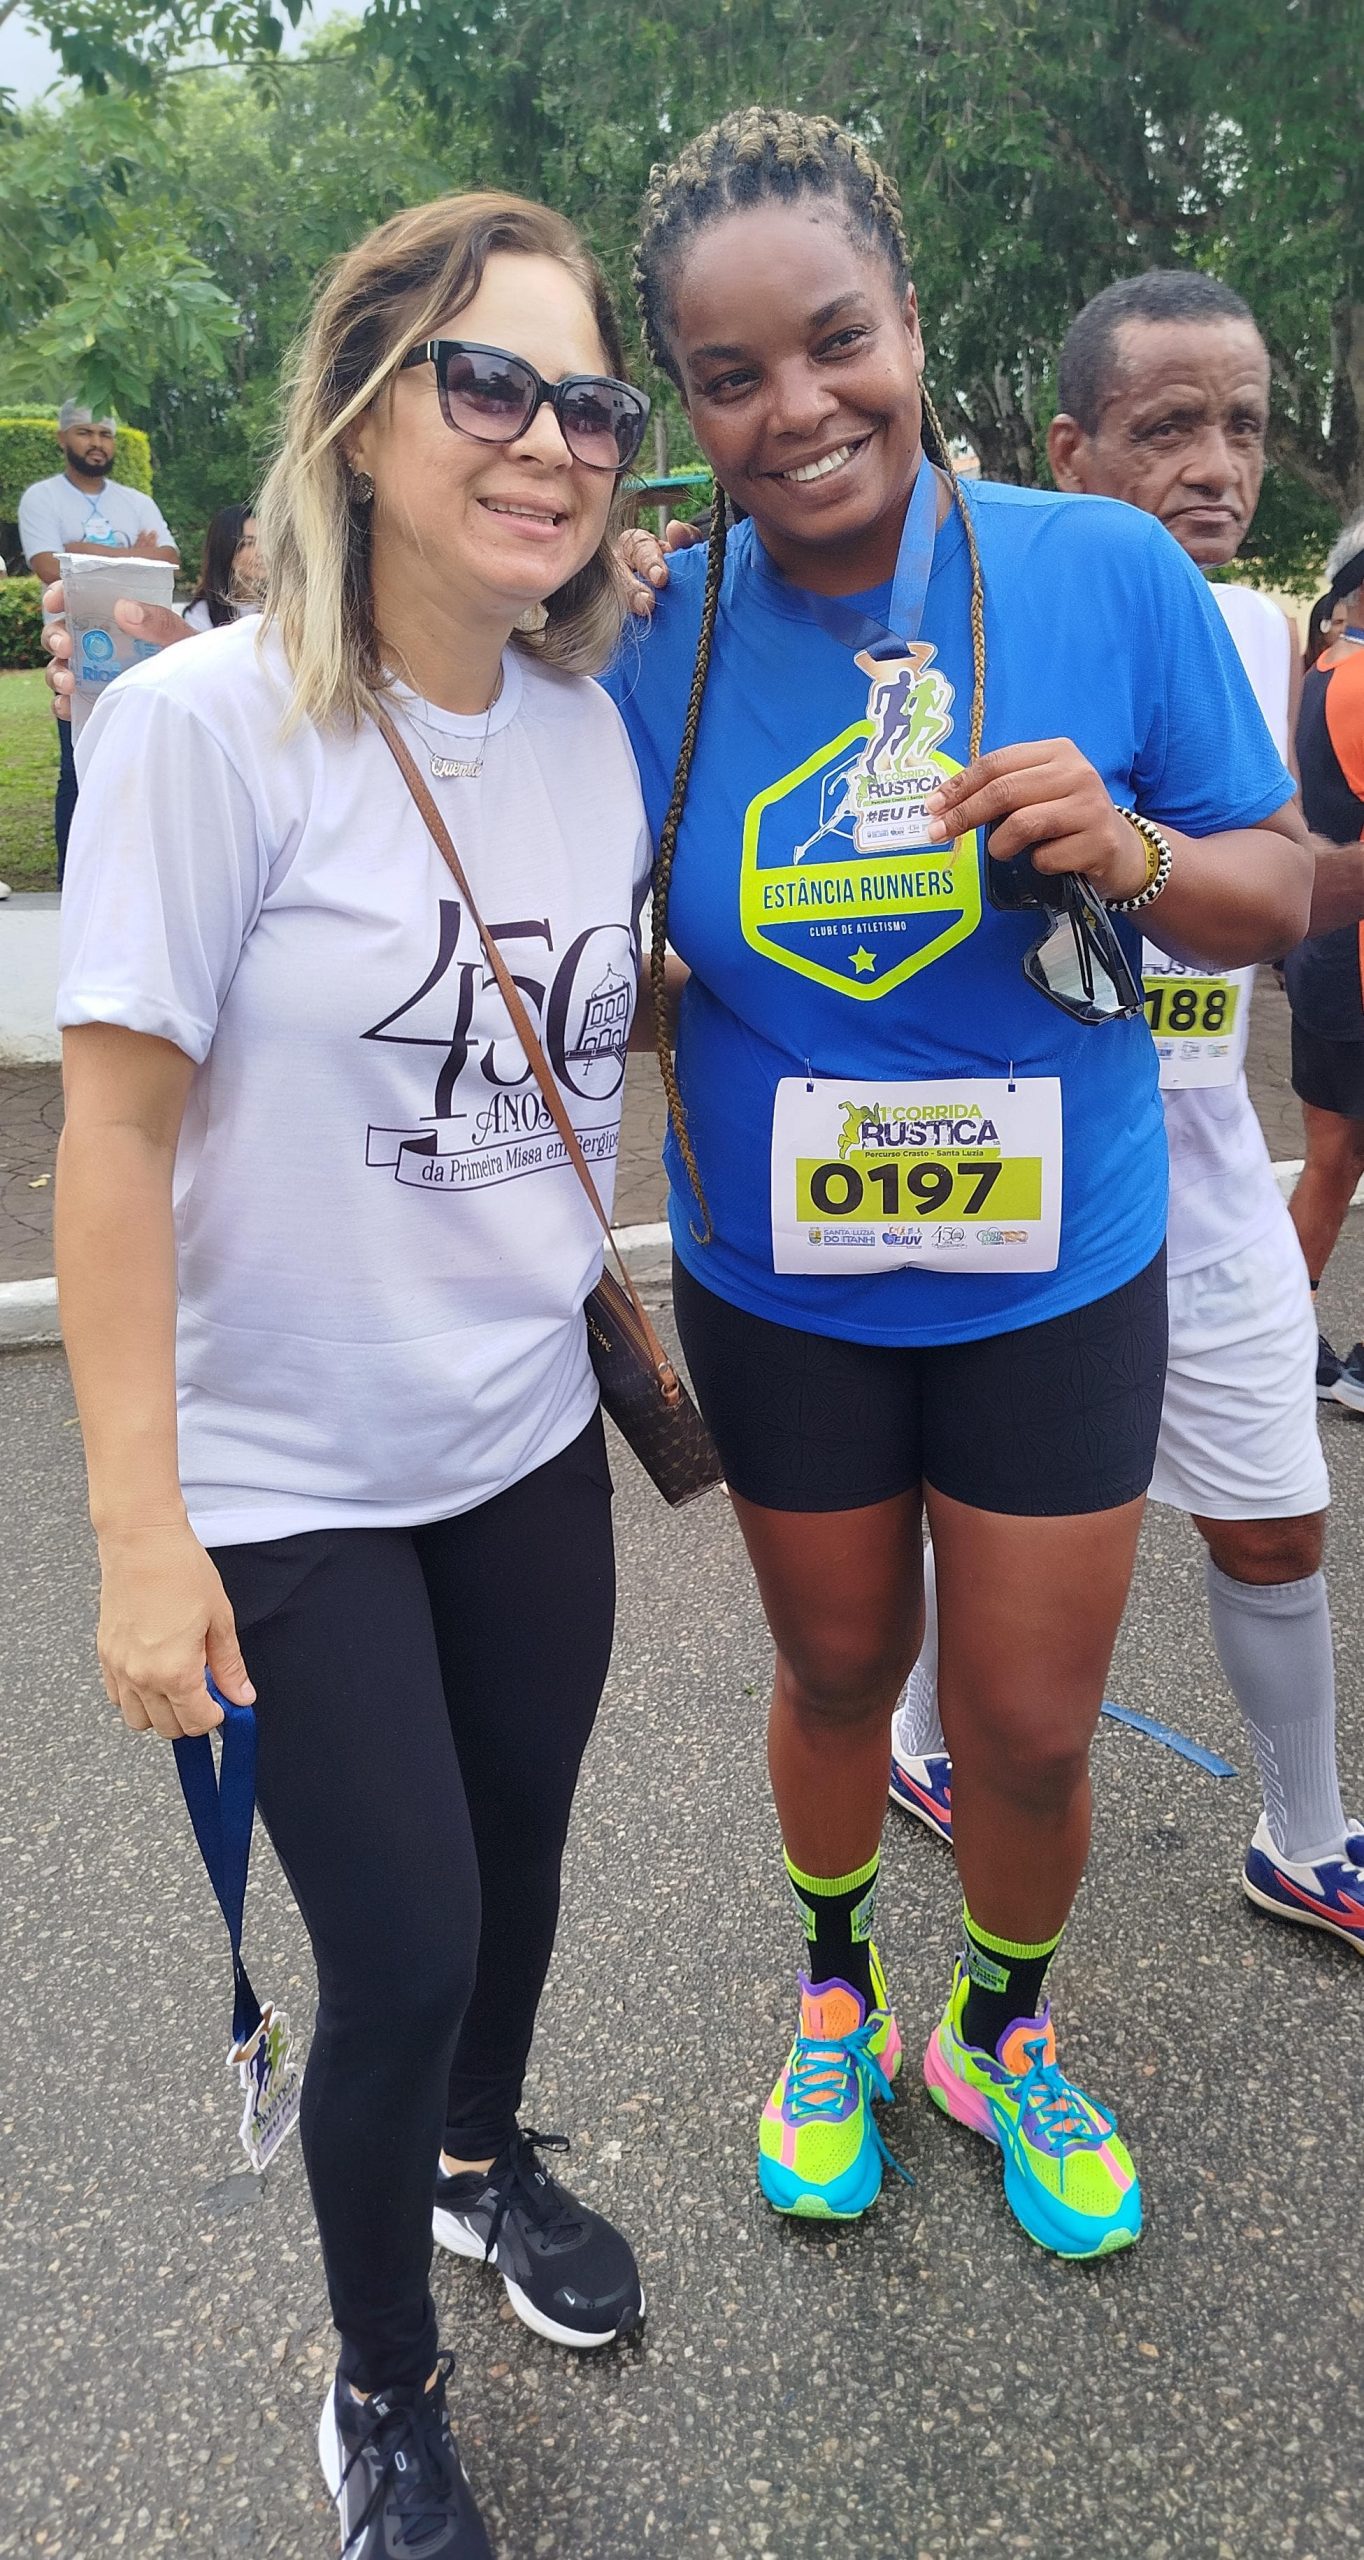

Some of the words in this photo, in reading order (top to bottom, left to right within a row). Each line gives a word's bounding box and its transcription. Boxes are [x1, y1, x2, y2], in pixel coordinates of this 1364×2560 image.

[885, 768, 934, 781] CORRIDA
[866, 807, 904, 823] #EU
[764, 877, 855, 909] ESTÂNCIA
[862, 870, 954, 901] RUNNERS
[809, 924, 839, 937] CLUBE
[841, 923, 853, 935] DE
[856, 920, 907, 934] ATLETISMO
[360, 899, 639, 1121] 450
[472, 1091, 554, 1146] ANOS
[892, 1104, 983, 1121] CORRIDA
[865, 1149, 901, 1158] Percurso
[902, 1149, 929, 1157] Crasto
[936, 1149, 960, 1157] Santa
[962, 1149, 984, 1157] Luzia
[421, 1158, 444, 1182] da
[450, 1151, 504, 1184] Primeira
[506, 1145, 543, 1171] Missa
[546, 1141, 568, 1160] em
[810, 1162, 1003, 1216] 0197
[824, 1235, 840, 1243] DO
[842, 1235, 876, 1244] ITANHI
